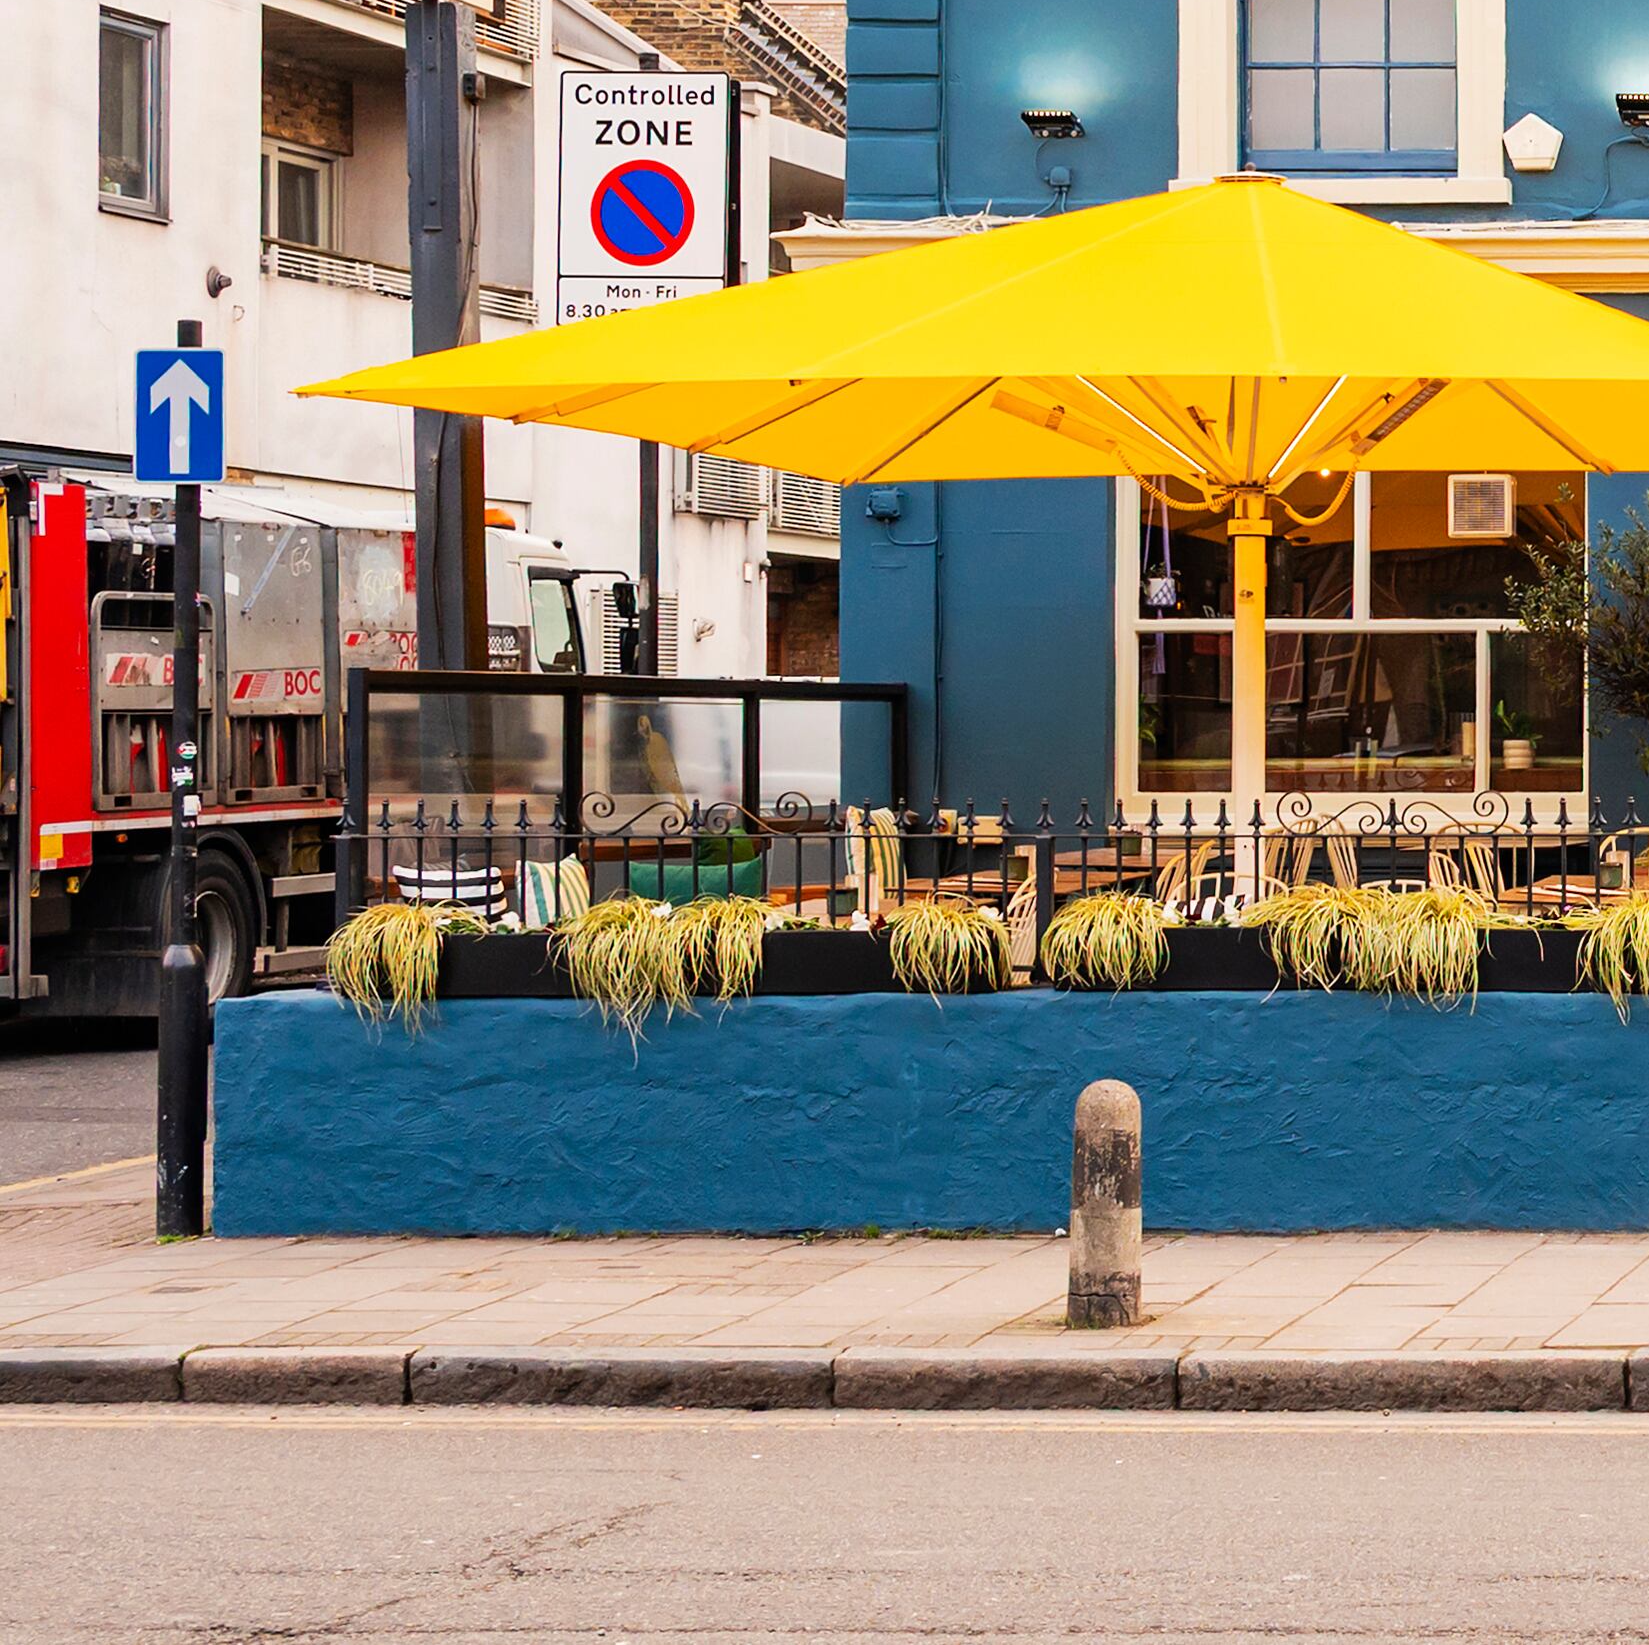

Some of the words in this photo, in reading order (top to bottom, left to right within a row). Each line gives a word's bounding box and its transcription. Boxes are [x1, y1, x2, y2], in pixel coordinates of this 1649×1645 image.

[575, 84, 714, 105] Controlled
[595, 120, 692, 145] ZONE
[606, 286, 640, 298] Mon
[656, 286, 676, 298] Fri
[566, 305, 605, 318] 8.30
[284, 670, 320, 696] BOC
